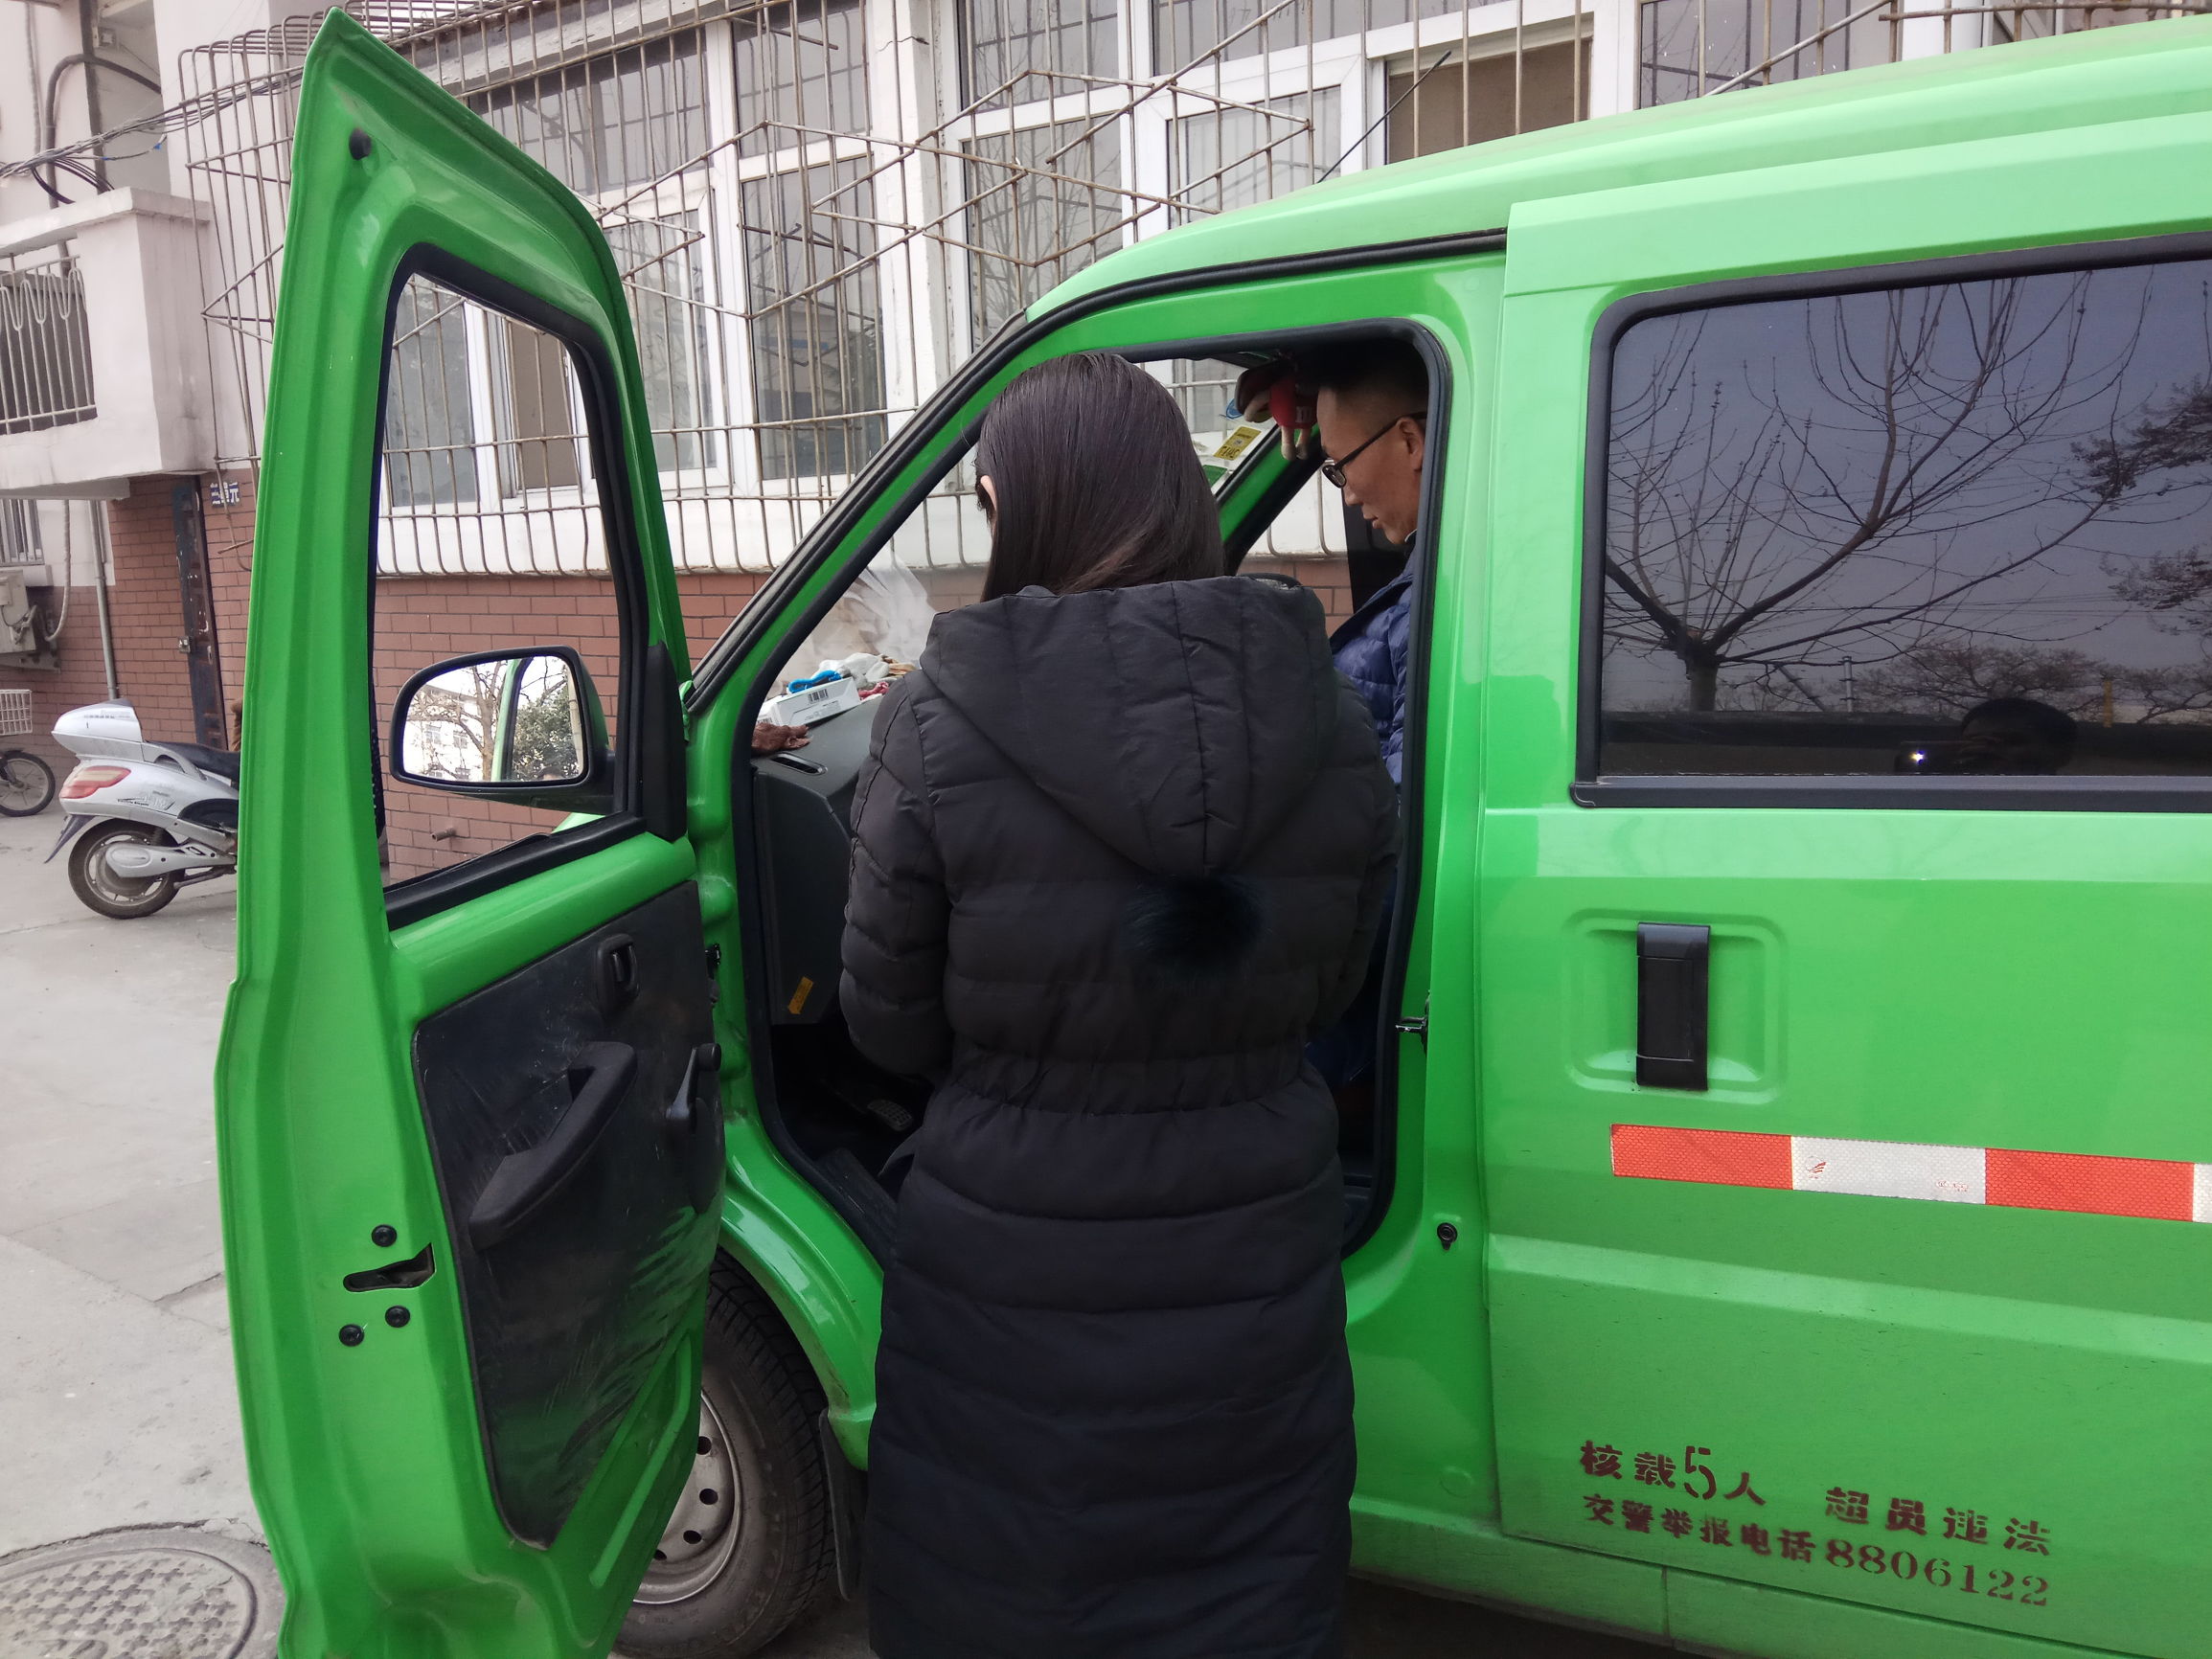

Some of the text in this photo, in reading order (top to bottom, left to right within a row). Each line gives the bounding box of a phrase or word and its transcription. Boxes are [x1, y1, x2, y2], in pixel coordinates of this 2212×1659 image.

[1580, 1440, 2052, 1557] 核载5人 超员违法
